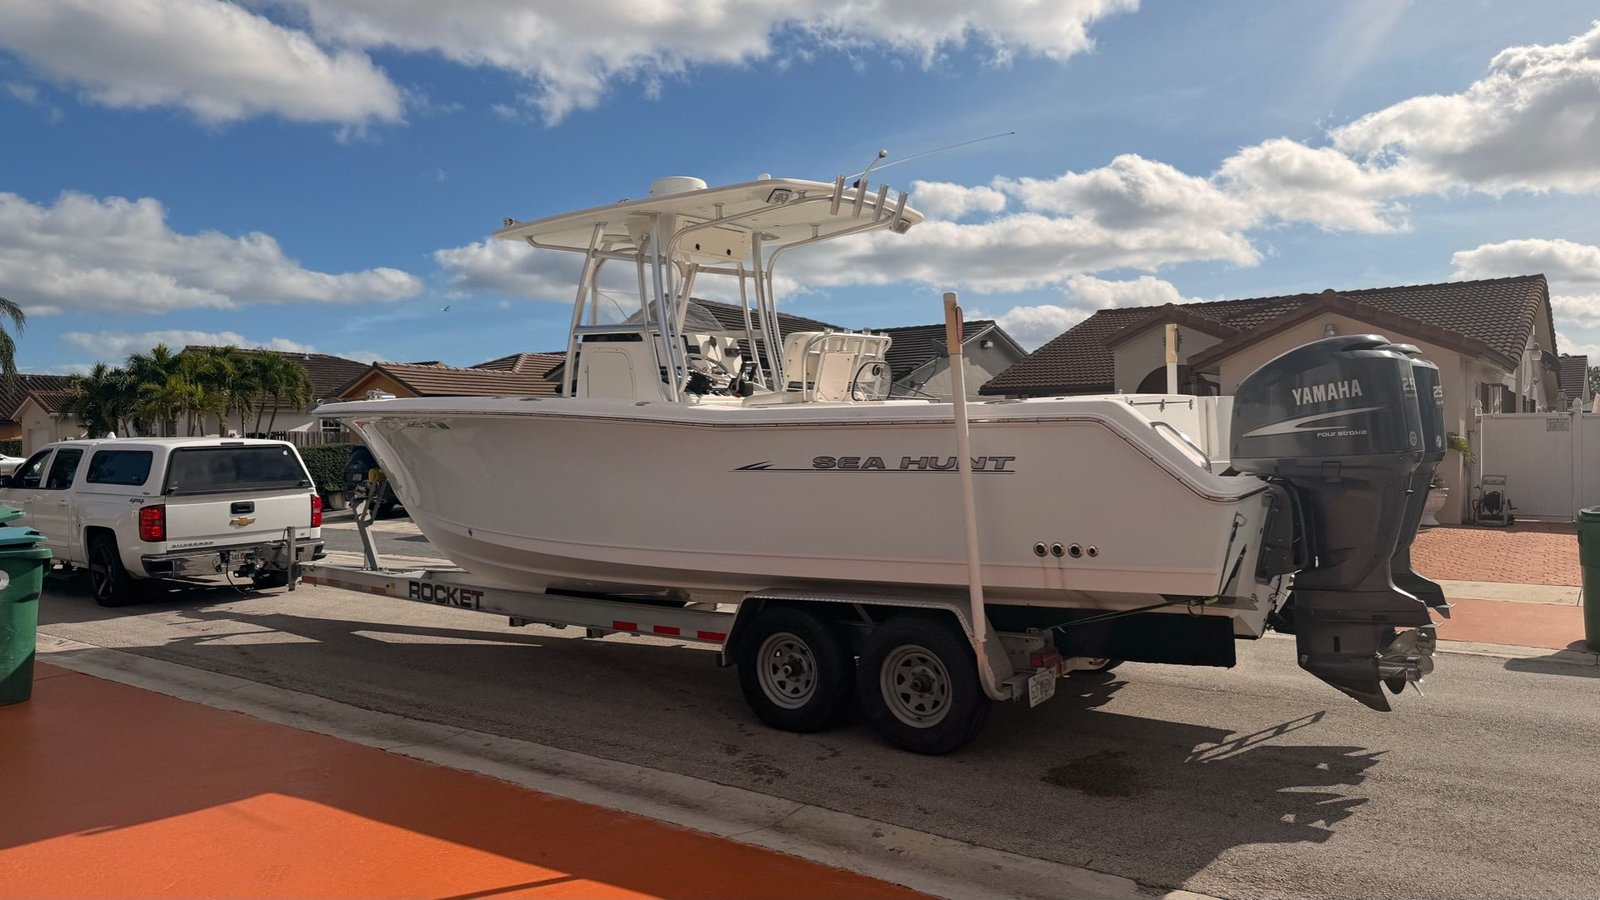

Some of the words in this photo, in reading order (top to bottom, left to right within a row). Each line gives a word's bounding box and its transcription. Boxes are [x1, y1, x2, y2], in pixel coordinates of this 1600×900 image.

[1292, 379, 1363, 406] YAMAHA
[812, 456, 886, 469] SEA
[900, 456, 1016, 470] HUNT
[409, 581, 484, 609] ROCKET
